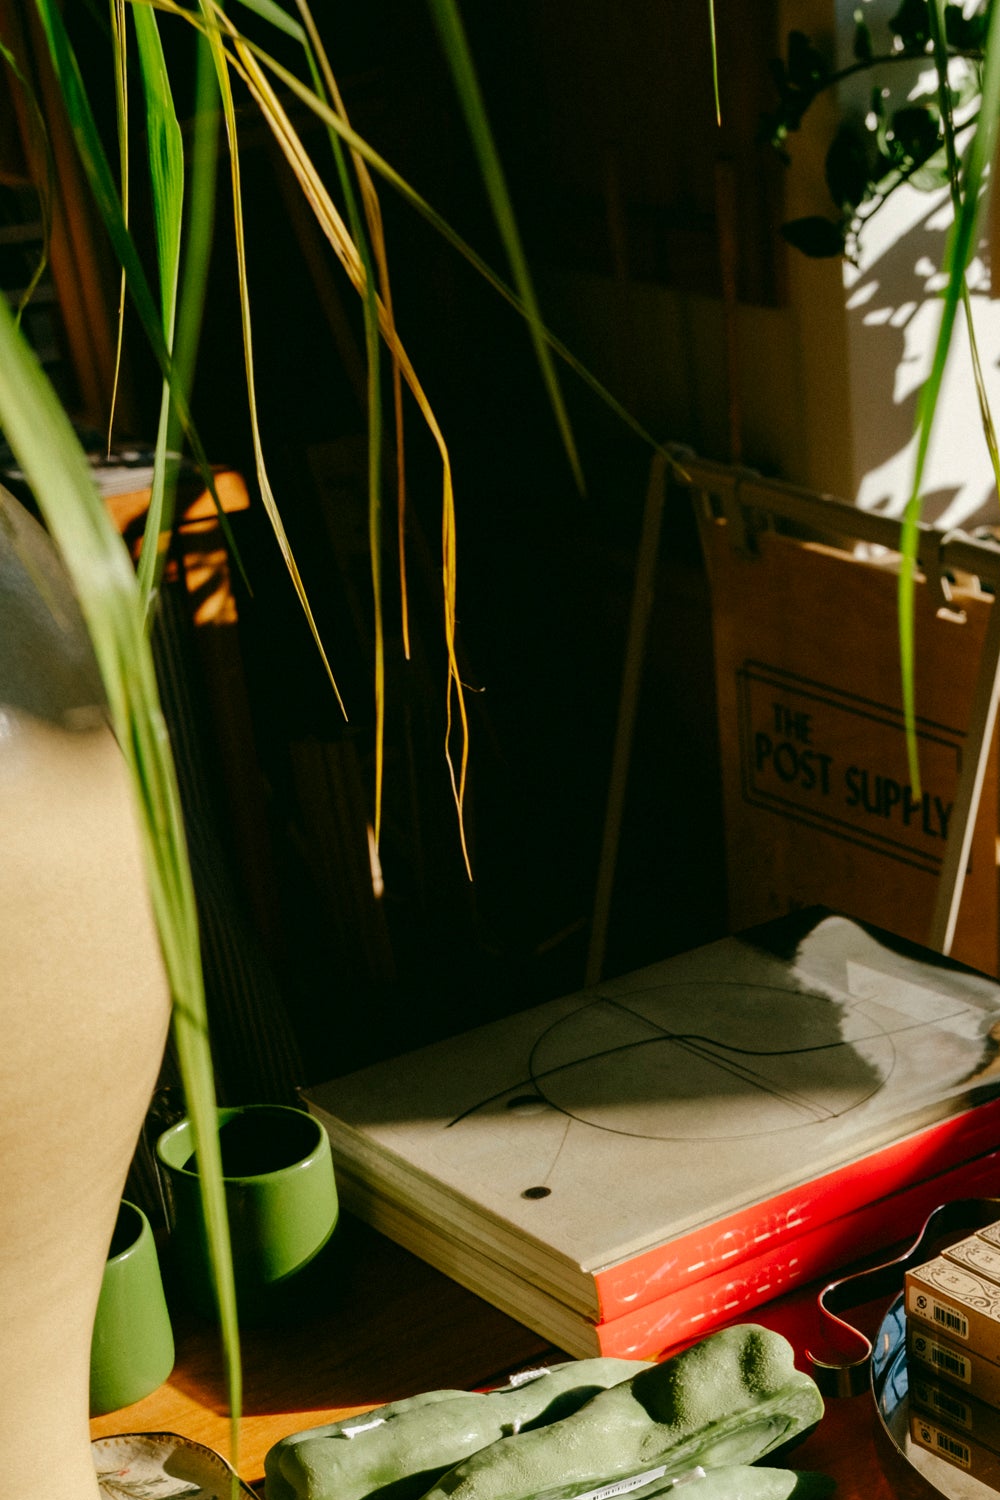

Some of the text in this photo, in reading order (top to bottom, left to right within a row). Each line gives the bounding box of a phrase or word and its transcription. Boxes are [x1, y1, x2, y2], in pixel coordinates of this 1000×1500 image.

[773, 703, 812, 744] THE
[755, 732, 952, 840] POST SUPPLY
